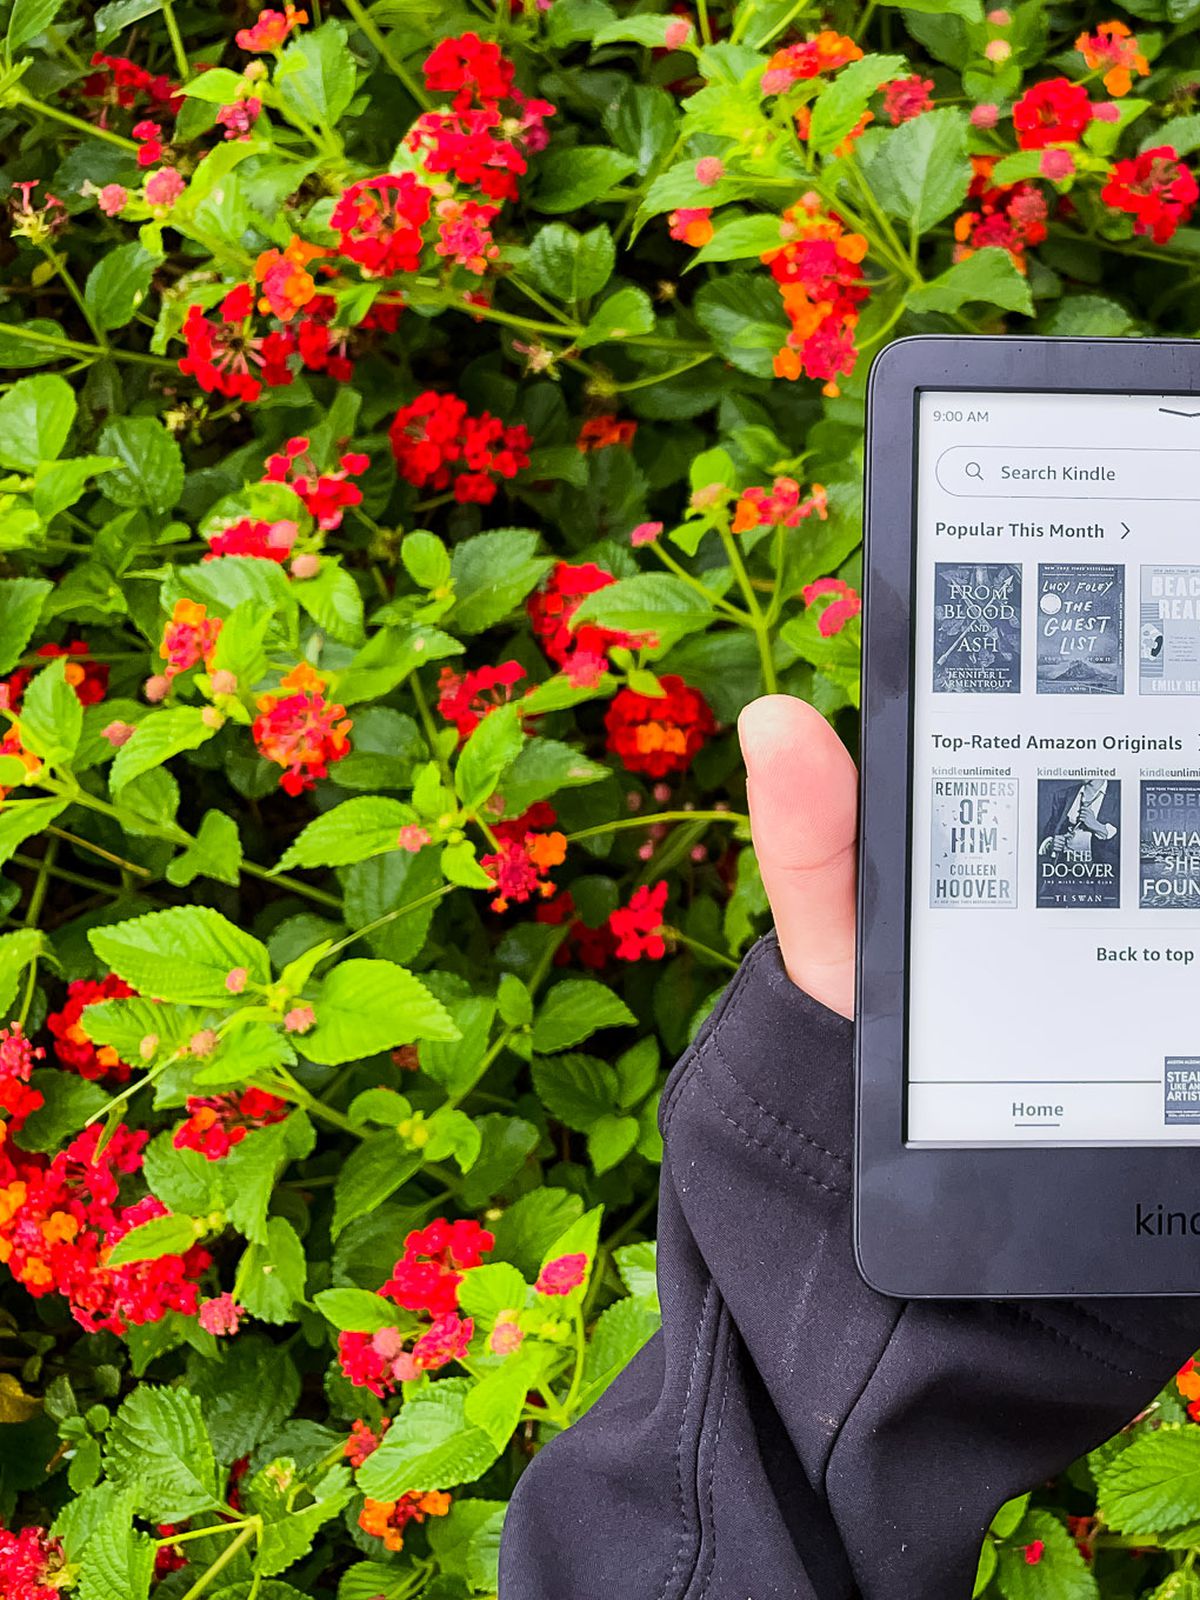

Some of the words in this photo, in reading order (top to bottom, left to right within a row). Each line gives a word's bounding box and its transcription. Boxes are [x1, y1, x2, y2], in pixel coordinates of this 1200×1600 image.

[933, 411, 963, 422] 9:00
[967, 411, 990, 422] AM
[1001, 465, 1057, 480] Search
[1062, 466, 1116, 481] Kindle
[935, 522, 1004, 539] Popular
[1008, 522, 1044, 538] This
[1050, 523, 1105, 538] Month
[949, 585, 1009, 600] FROM
[1042, 580, 1070, 593] LUCY
[1075, 580, 1113, 596] FOLEY
[943, 604, 1014, 620] BLOOD
[1064, 601, 1093, 613] THE
[969, 624, 990, 633] AND
[1044, 616, 1111, 636] GUEST
[957, 637, 998, 652] ASH
[1060, 636, 1097, 655] LIST
[947, 671, 996, 680] JENNIFER
[941, 679, 1012, 688] ARMENTROUT
[1152, 680, 1183, 692] EMILY
[932, 734, 1021, 752] Top-Rated
[1026, 735, 1097, 750] Amazon
[1102, 735, 1182, 753] Originals
[932, 767, 1011, 776] kindleunlimited
[1037, 767, 1116, 777] kindleunlimited
[935, 782, 1015, 796] REMINDERS
[959, 799, 990, 825] OF
[951, 828, 997, 853] HIM
[1063, 850, 1092, 862] THE
[1164, 856, 1200, 871] SHE
[950, 864, 996, 876] COLLEEN
[1042, 863, 1114, 878] DO-OVER
[936, 879, 1010, 898] HOOVER
[1097, 947, 1137, 962] Back
[1143, 948, 1161, 962] to
[1165, 948, 1195, 965] top
[1170, 1083, 1187, 1091] LIKE
[1011, 1102, 1064, 1117] Home
